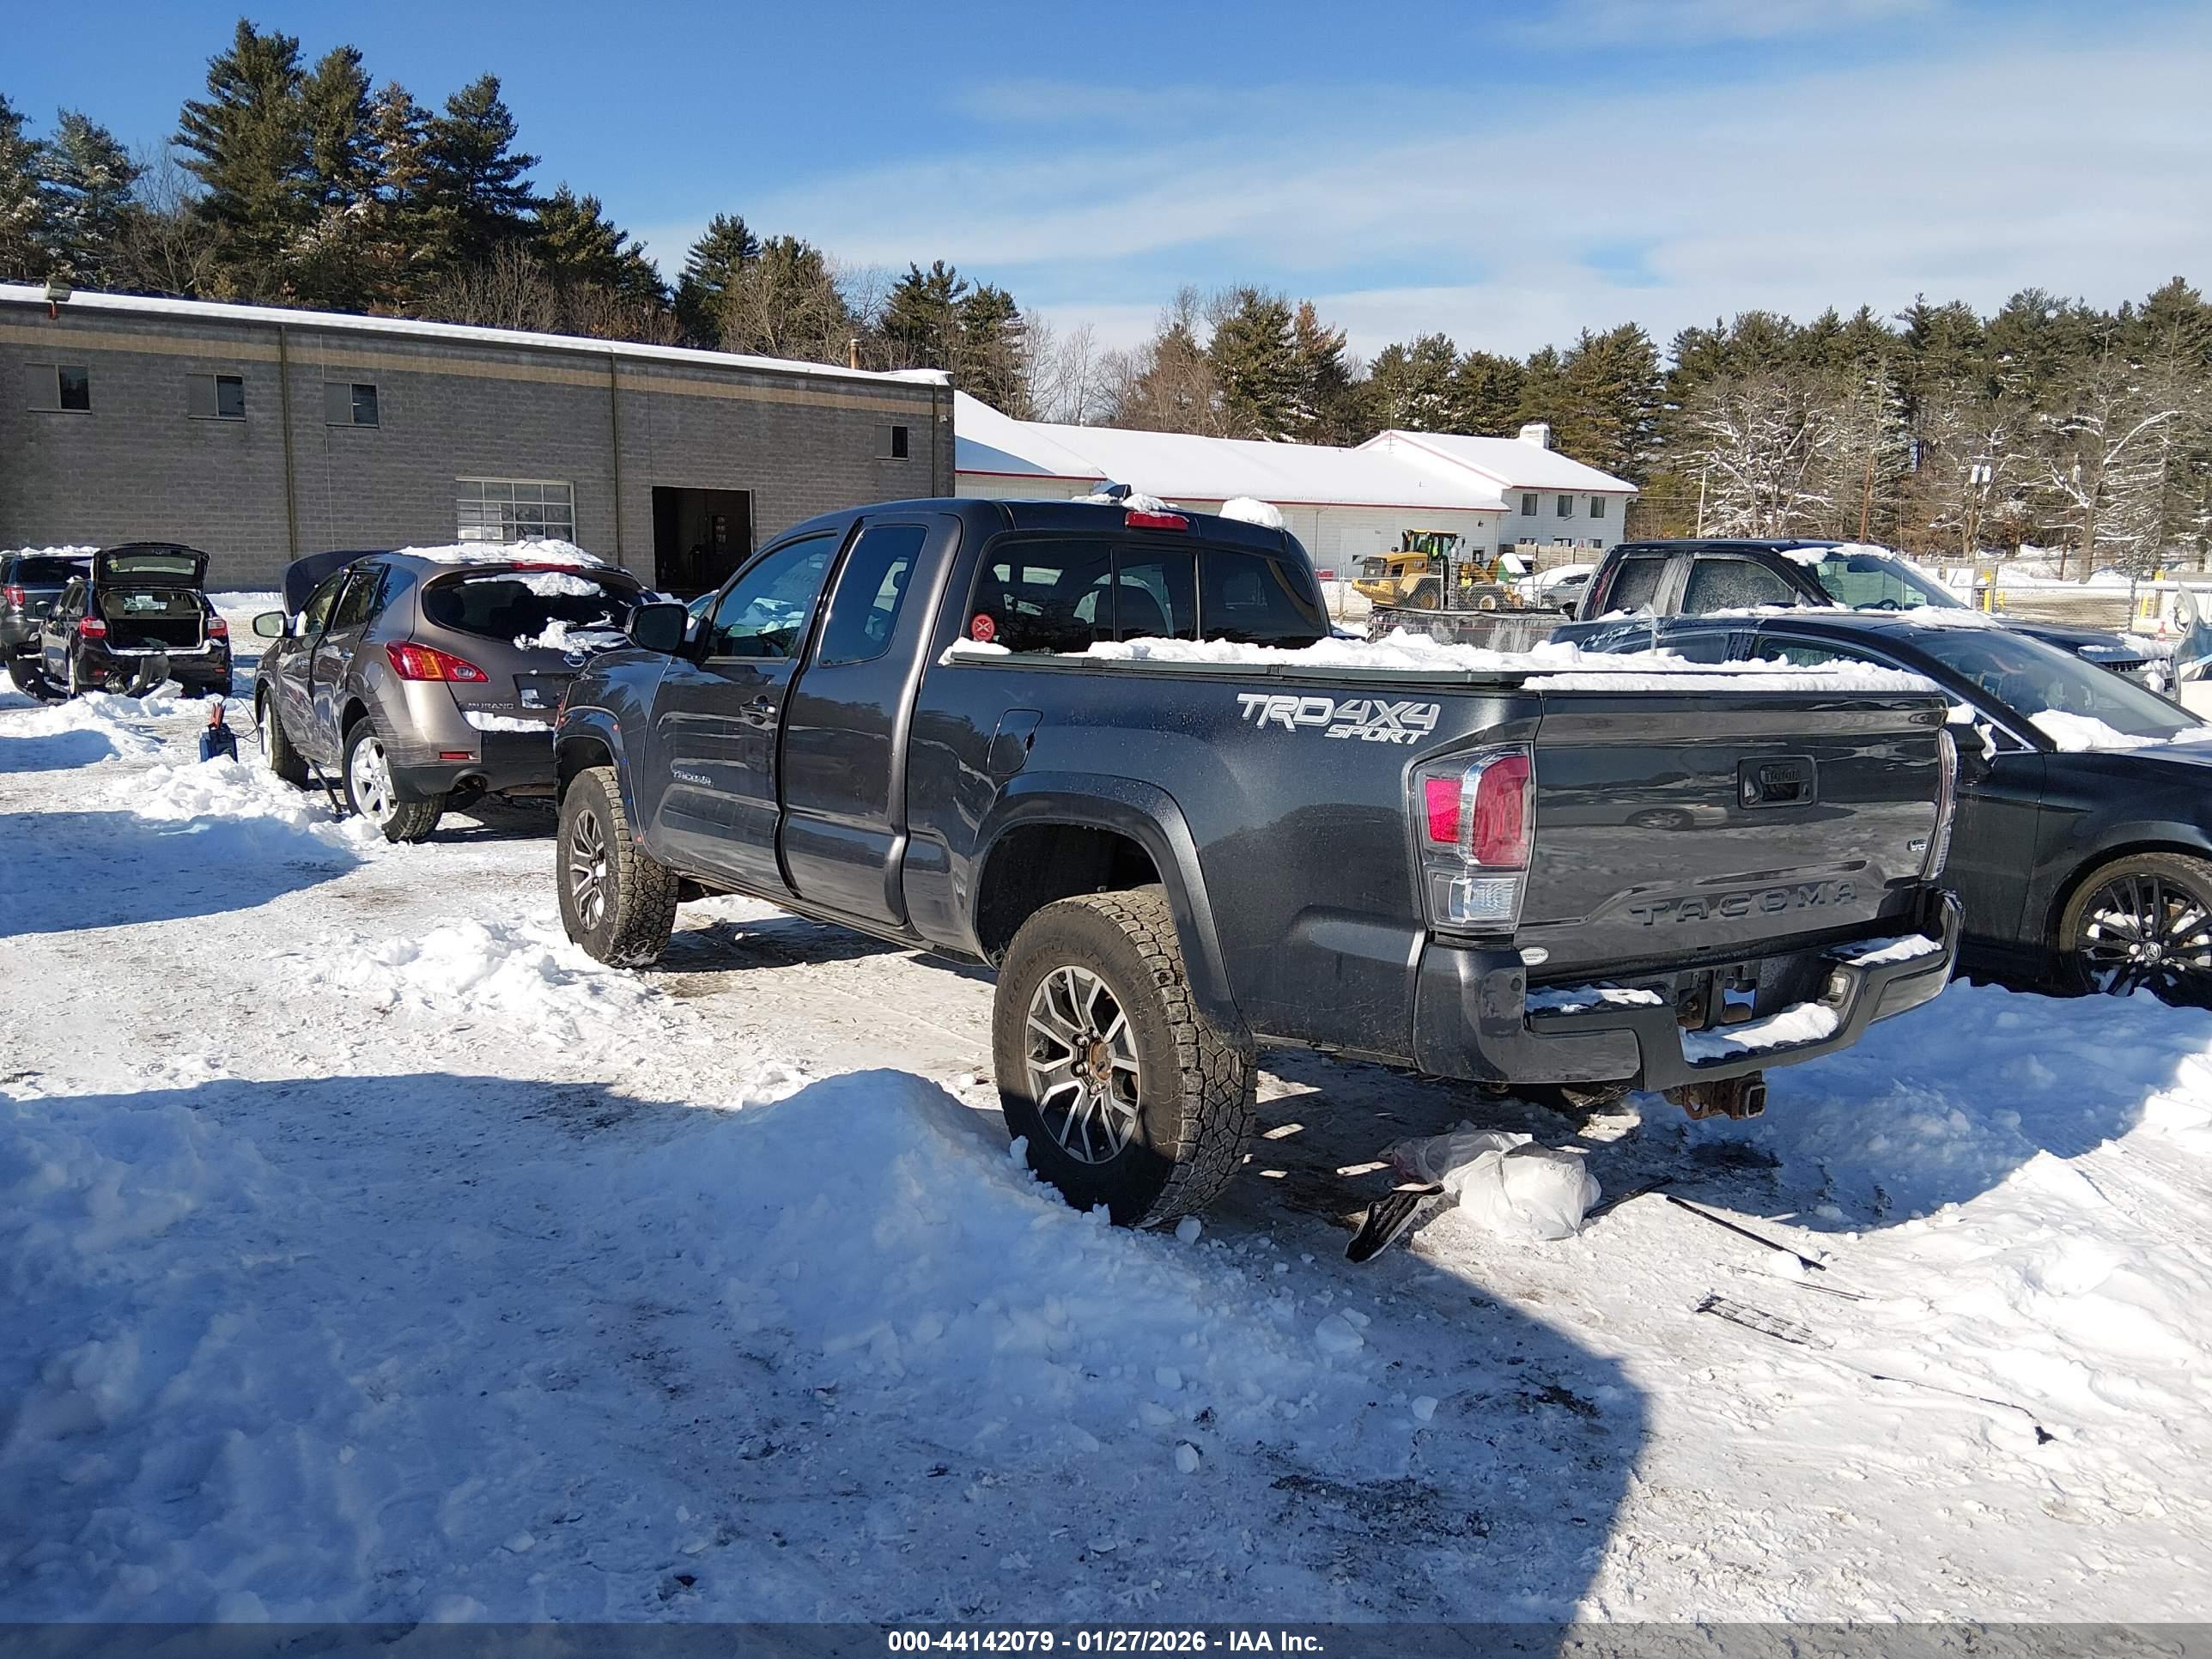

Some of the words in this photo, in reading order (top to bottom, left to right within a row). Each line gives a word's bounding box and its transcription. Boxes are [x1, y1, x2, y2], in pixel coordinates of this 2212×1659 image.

[1237, 693, 1334, 732] TRD
[1324, 724, 1430, 744] SPORT
[1908, 839, 1927, 852] V6
[1629, 878, 1859, 927] TACOMA
